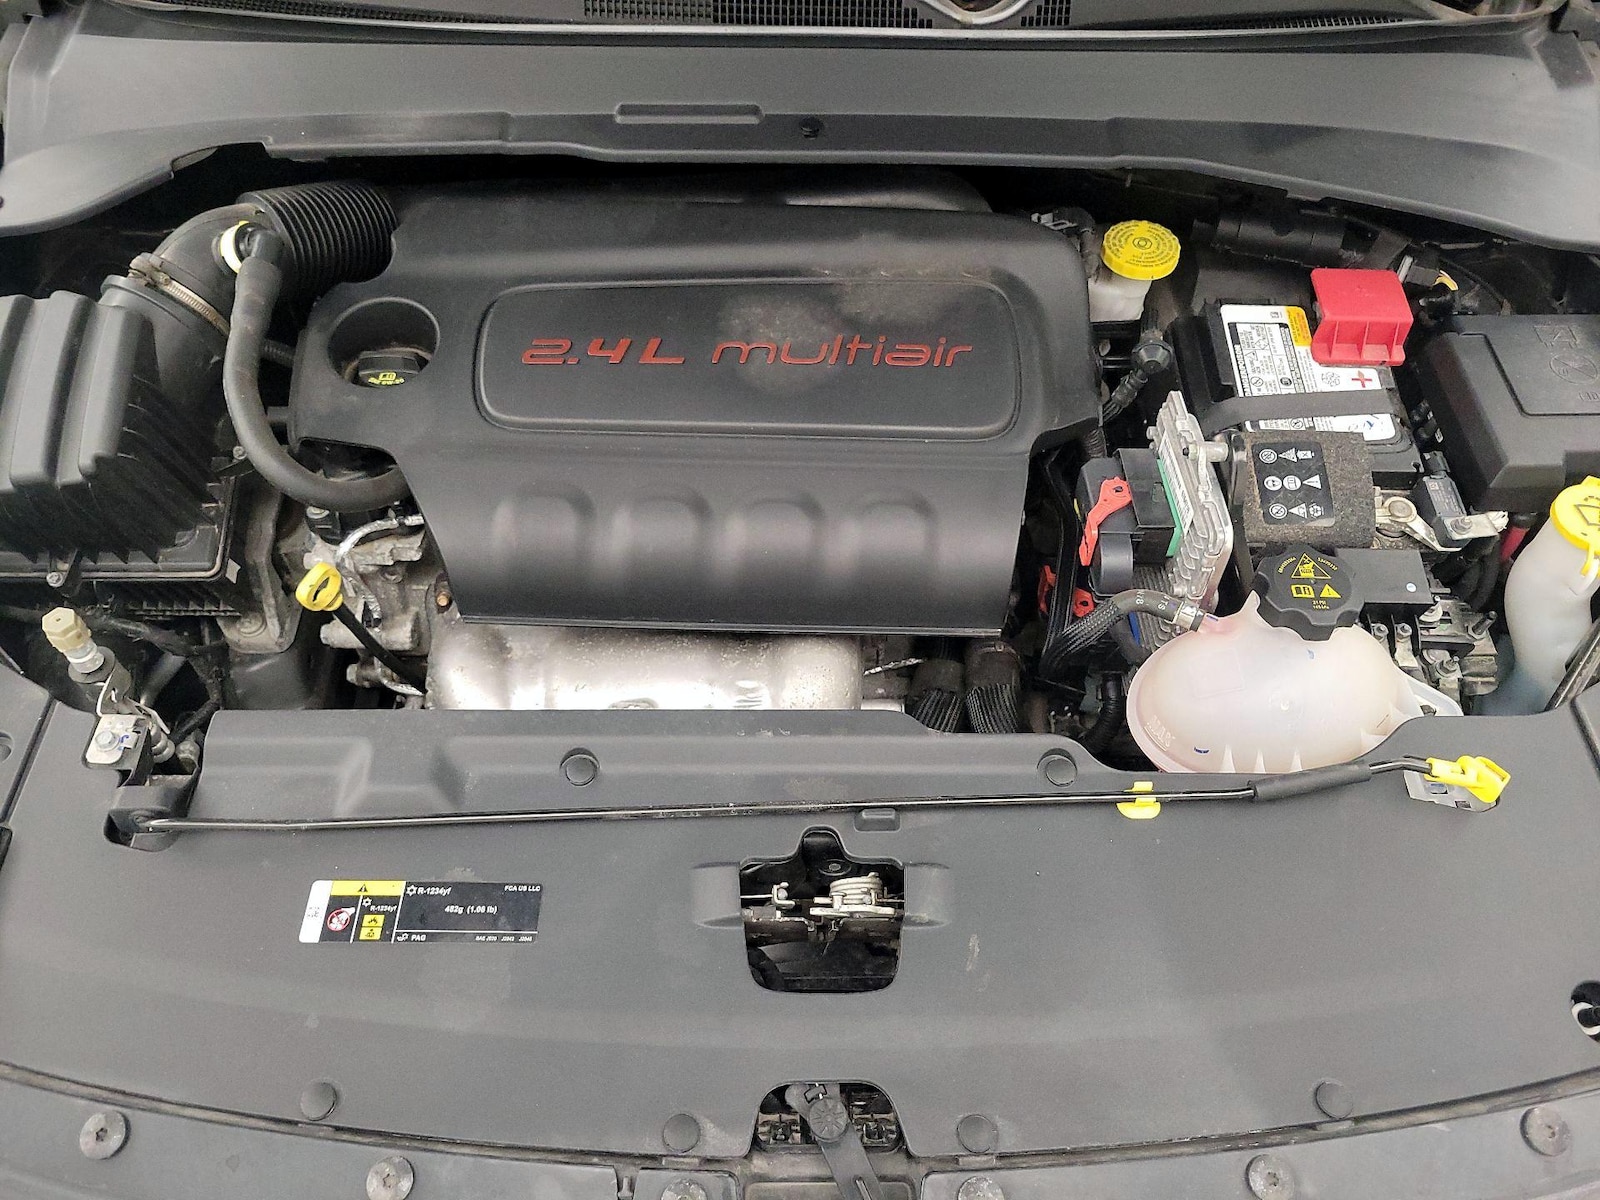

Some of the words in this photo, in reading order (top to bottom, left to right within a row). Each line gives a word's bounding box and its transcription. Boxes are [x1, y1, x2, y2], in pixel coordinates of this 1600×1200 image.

[711, 334, 973, 367] multiair
[417, 885, 451, 896] R-1234yf
[411, 933, 426, 942] PAG
